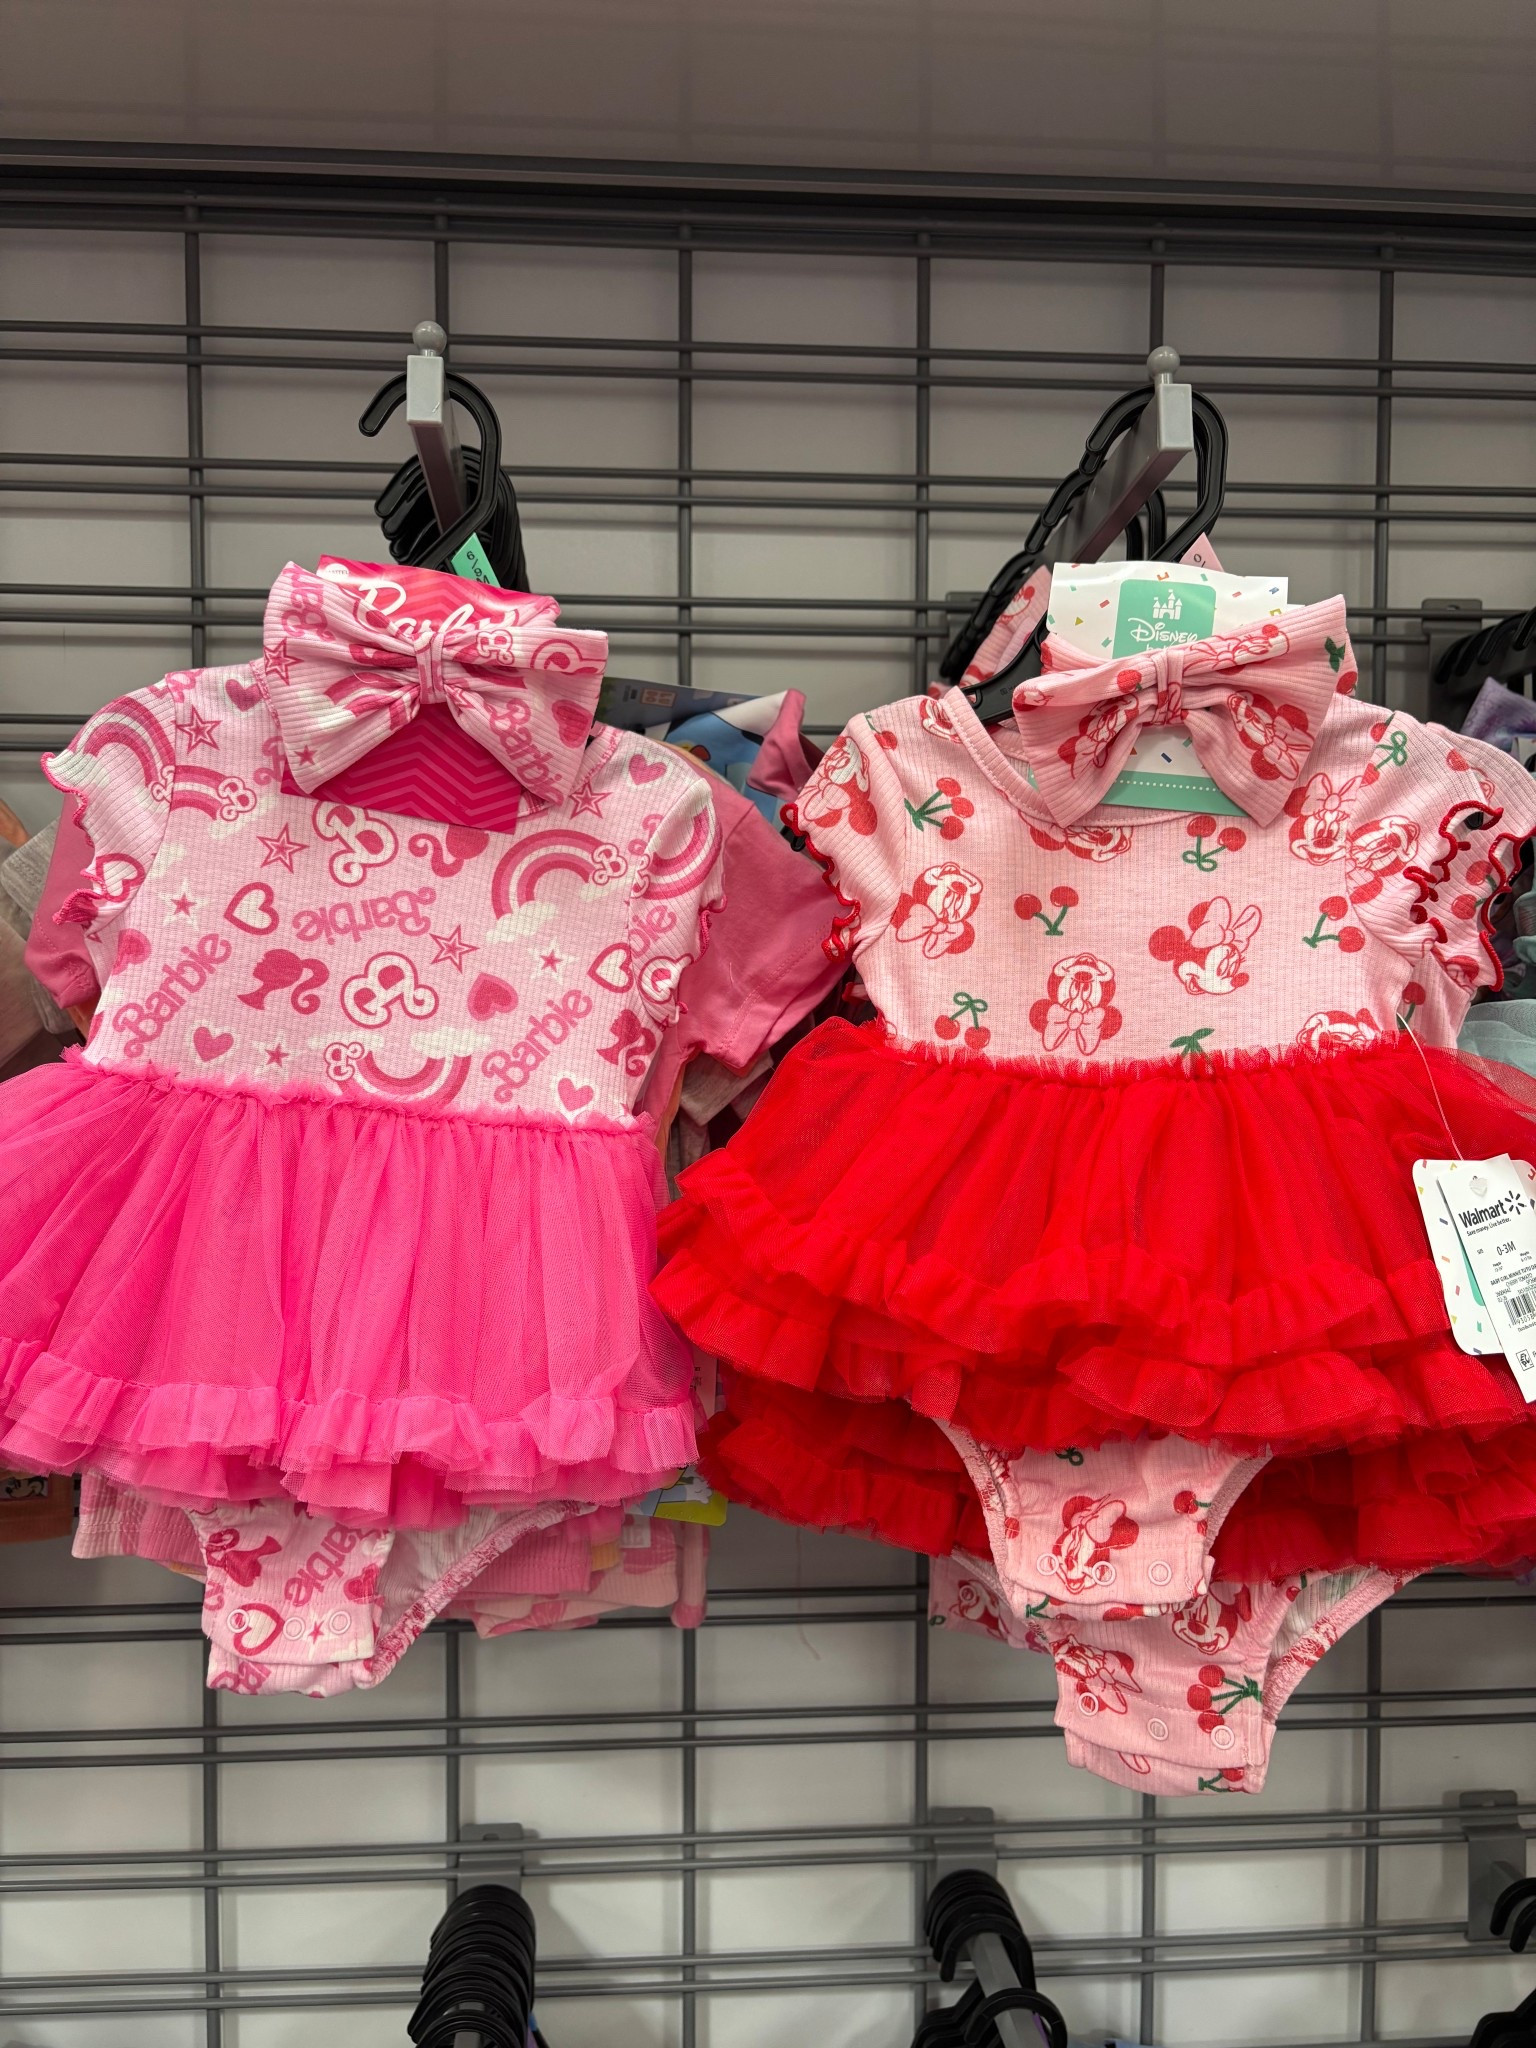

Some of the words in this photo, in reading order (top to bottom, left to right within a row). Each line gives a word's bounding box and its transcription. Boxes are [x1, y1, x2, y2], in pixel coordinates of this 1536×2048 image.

[292, 887, 436, 945] Barbie
[112, 933, 232, 1058] Barbie
[481, 989, 593, 1103] Barbie
[1458, 1199, 1507, 1228] Walmart
[1496, 1241, 1517, 1256] 0-3M
